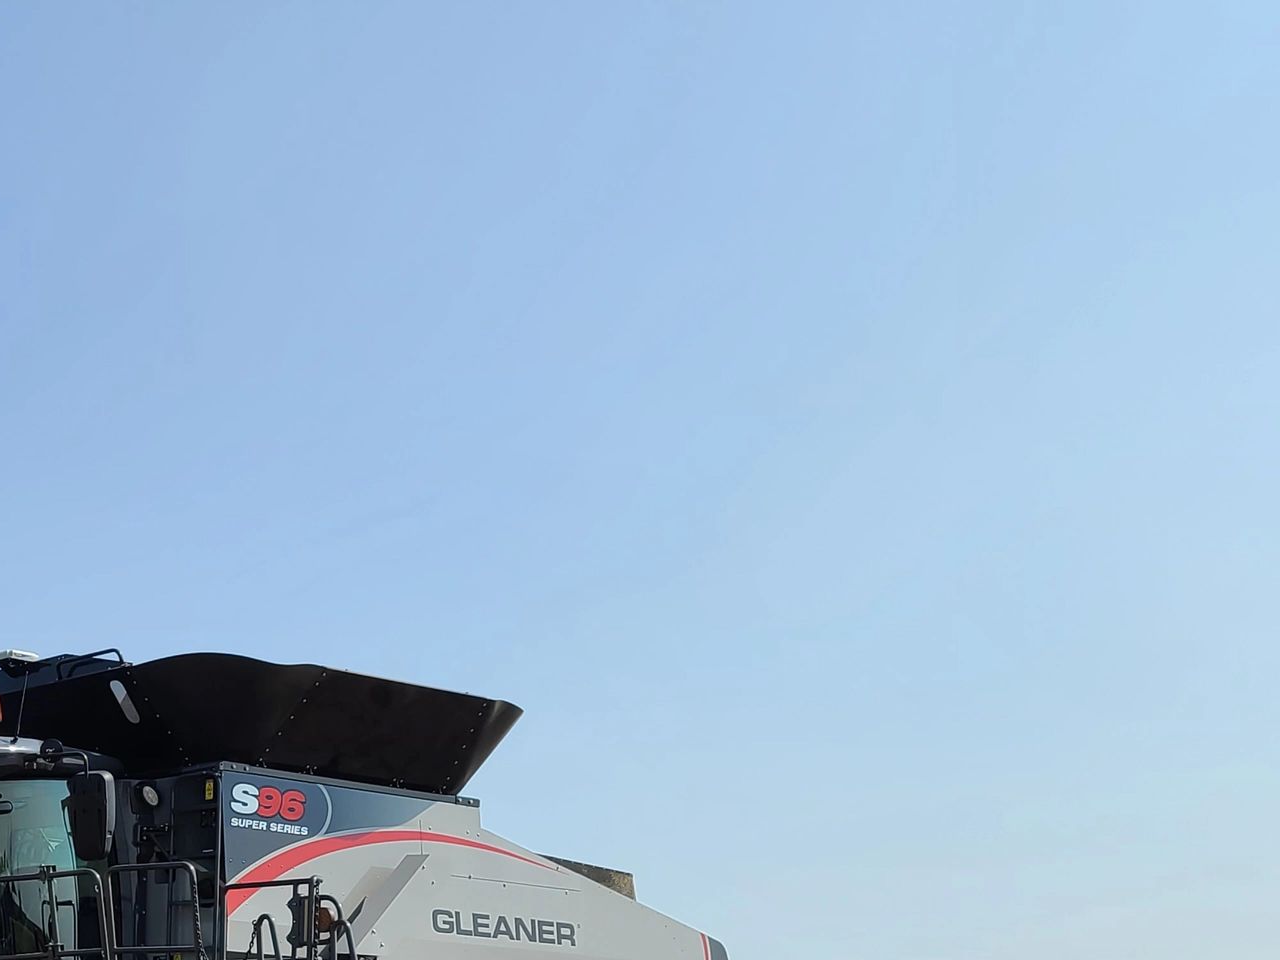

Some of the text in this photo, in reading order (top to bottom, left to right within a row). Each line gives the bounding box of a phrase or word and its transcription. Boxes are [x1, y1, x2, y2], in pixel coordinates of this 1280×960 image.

[230, 783, 306, 821] S96
[230, 817, 309, 836] SUPER SERIES
[431, 908, 577, 947] GLEANER
